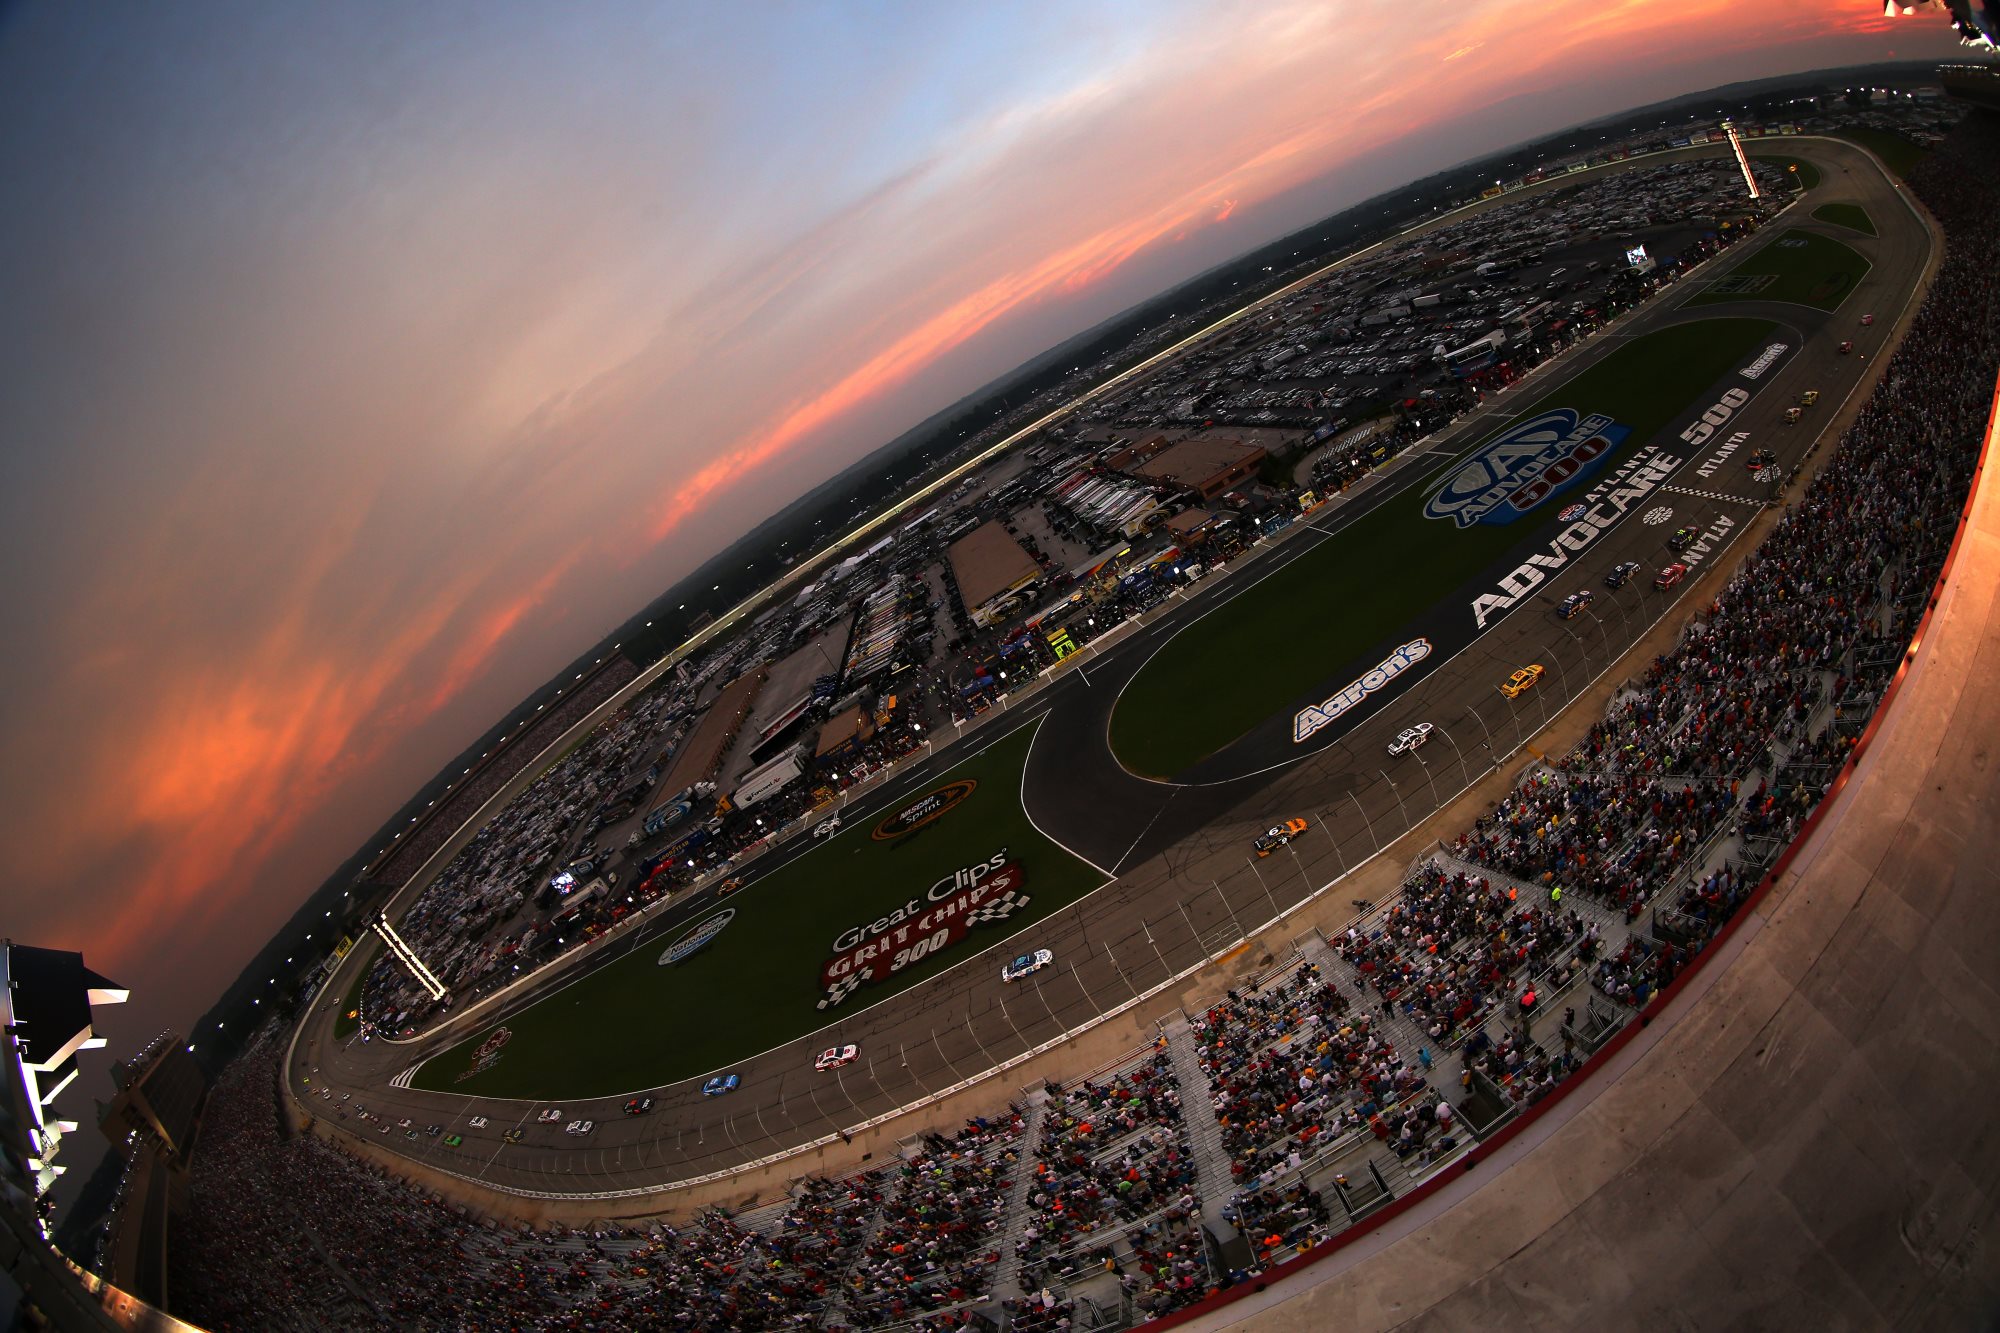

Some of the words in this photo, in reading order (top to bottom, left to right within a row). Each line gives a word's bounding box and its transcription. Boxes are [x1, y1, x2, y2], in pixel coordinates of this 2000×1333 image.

[1461, 417, 1605, 523] ADVOCARE
[1508, 437, 1612, 510] 500
[1585, 445, 1660, 503] ATLANTA
[1695, 431, 1750, 478] ATLANTA
[1470, 452, 1683, 630] ADVOCARE
[1679, 387, 1750, 446] 500
[1294, 637, 1433, 743] Aaron's
[905, 800, 941, 824] Sprint
[828, 924, 913, 977] GRIT
[918, 869, 1014, 930] CHIPS
[833, 899, 920, 953] Great
[928, 852, 1006, 901] Clips
[890, 928, 949, 972] 300
